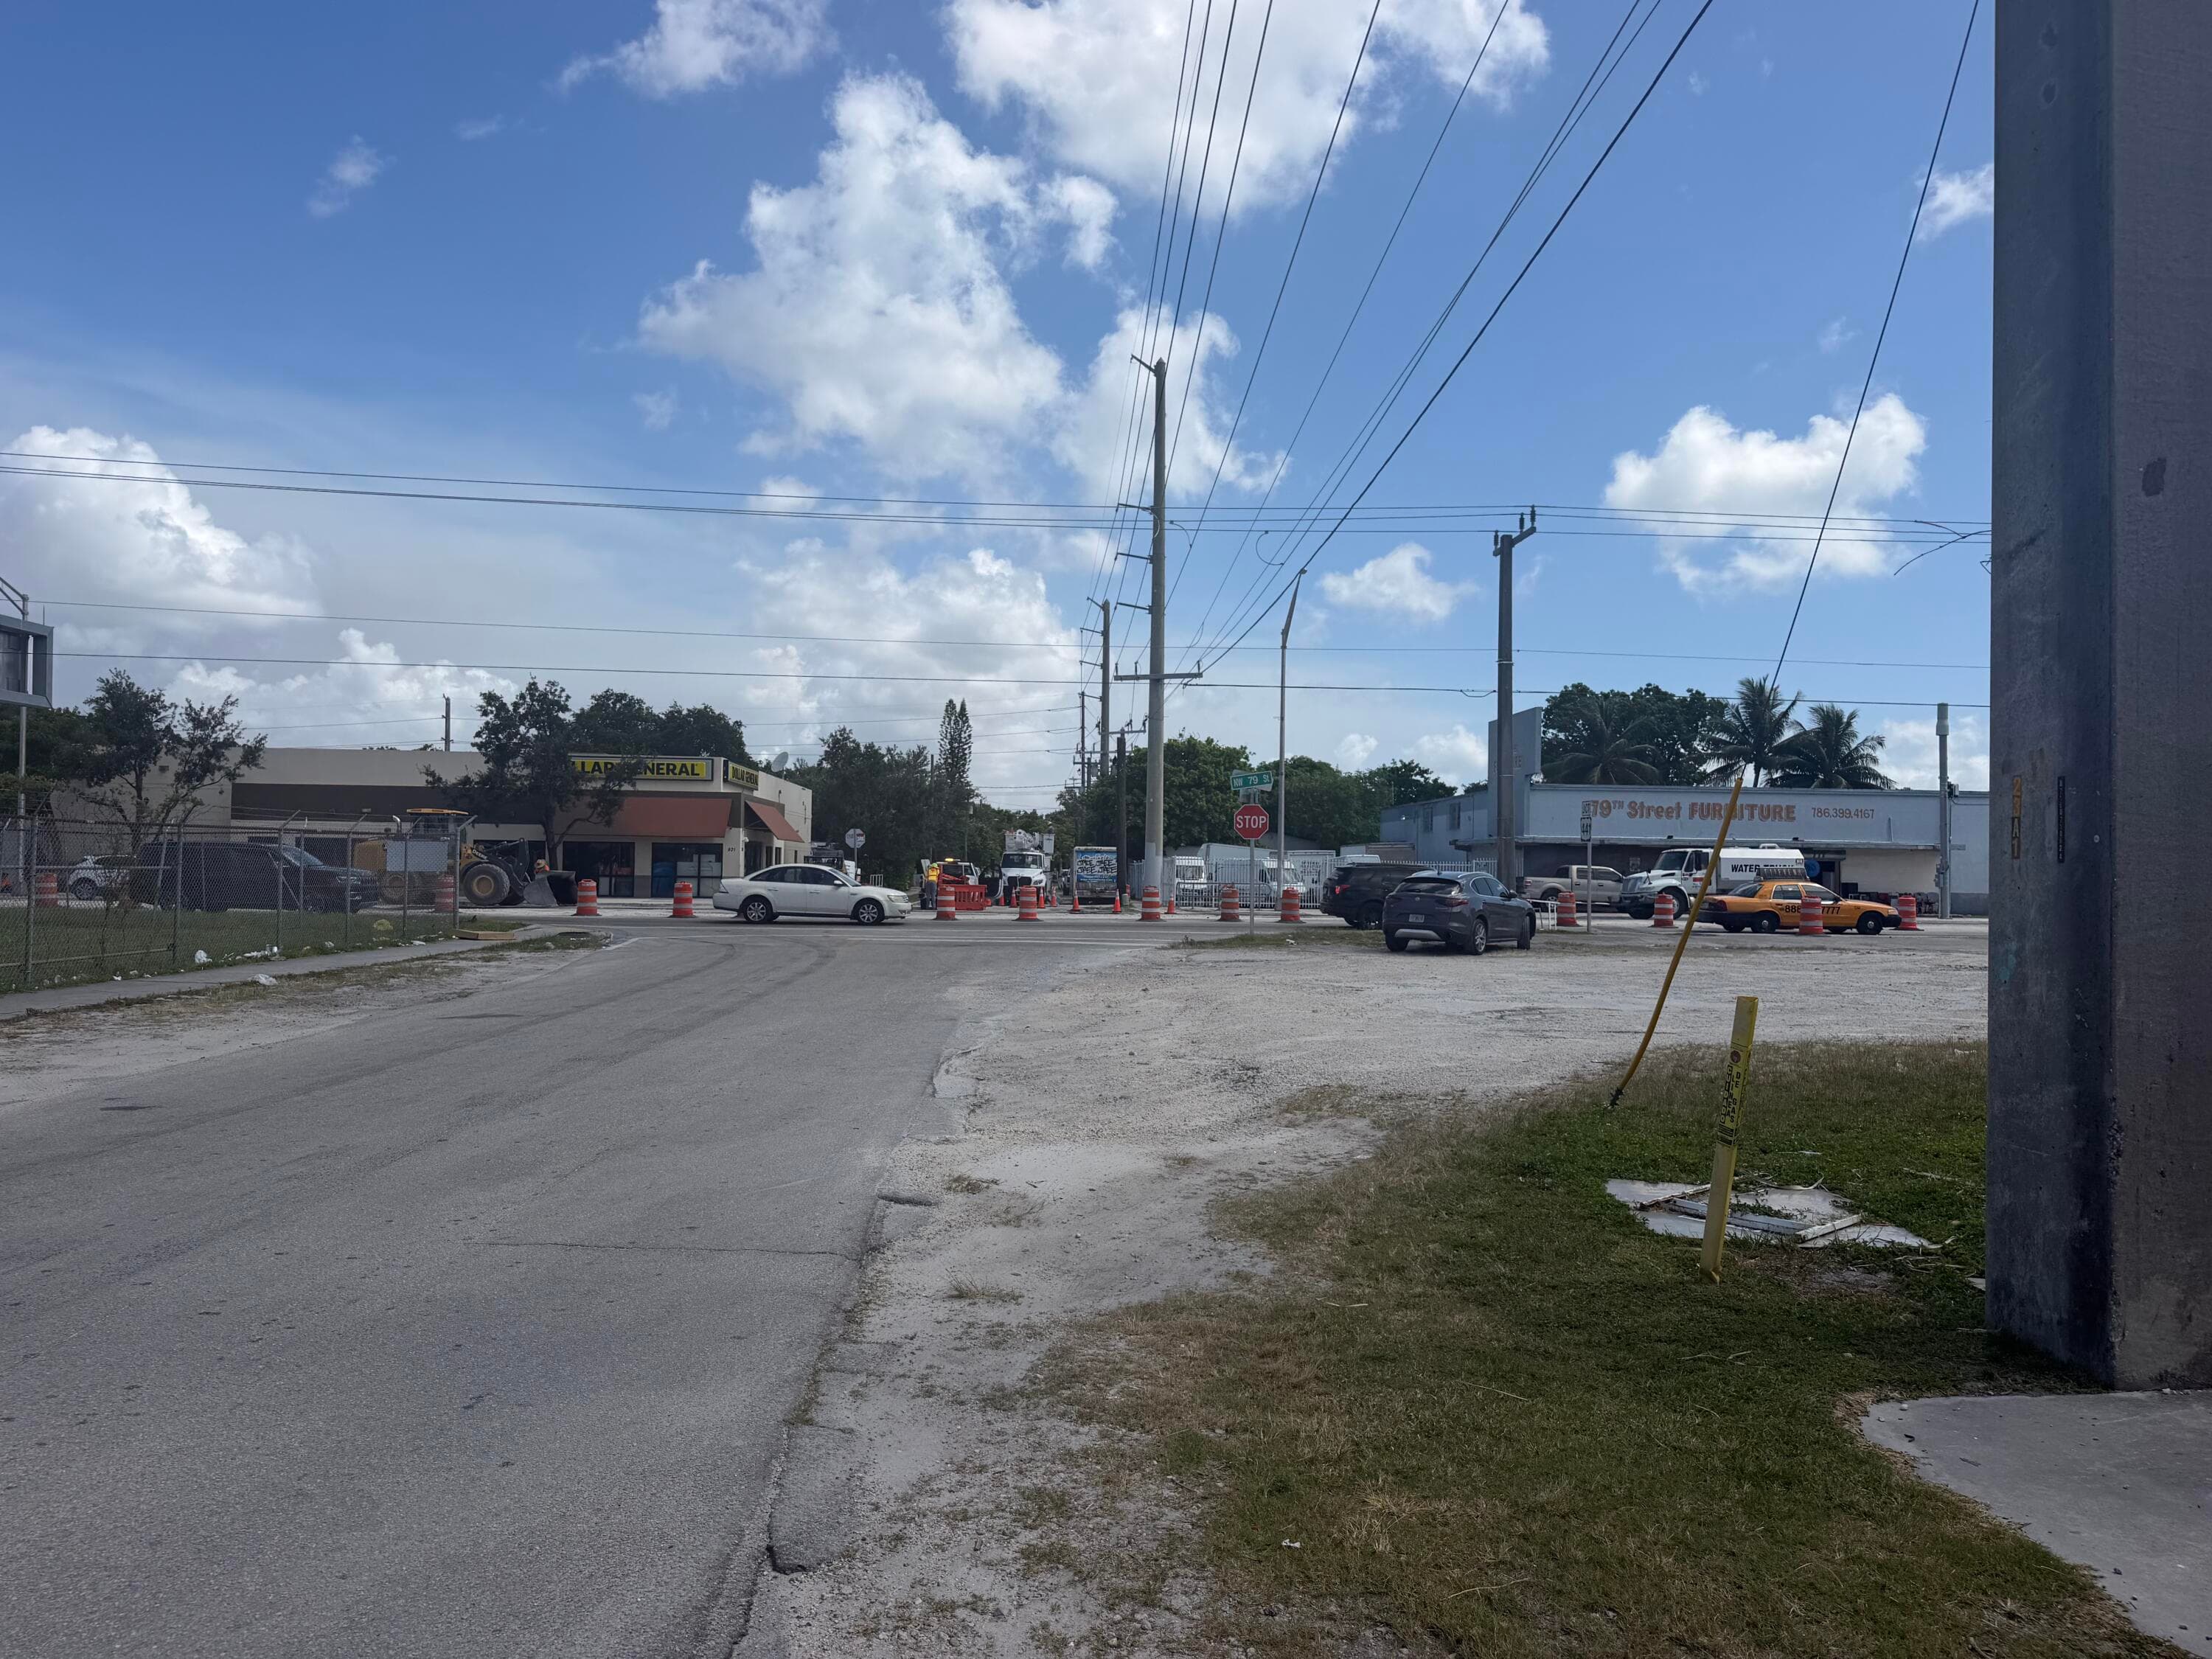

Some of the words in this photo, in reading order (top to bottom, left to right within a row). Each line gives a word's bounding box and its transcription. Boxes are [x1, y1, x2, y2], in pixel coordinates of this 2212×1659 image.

[641, 762, 700, 776] NERAL
[1234, 778, 1243, 787] NW
[1248, 776, 1259, 785] 79
[1627, 801, 1682, 820] Street
[1812, 807, 1874, 819] 786.399.4167
[1236, 815, 1267, 829] STOP
[1731, 864, 1760, 873] WATER
[1734, 1072, 1741, 1088] DE
